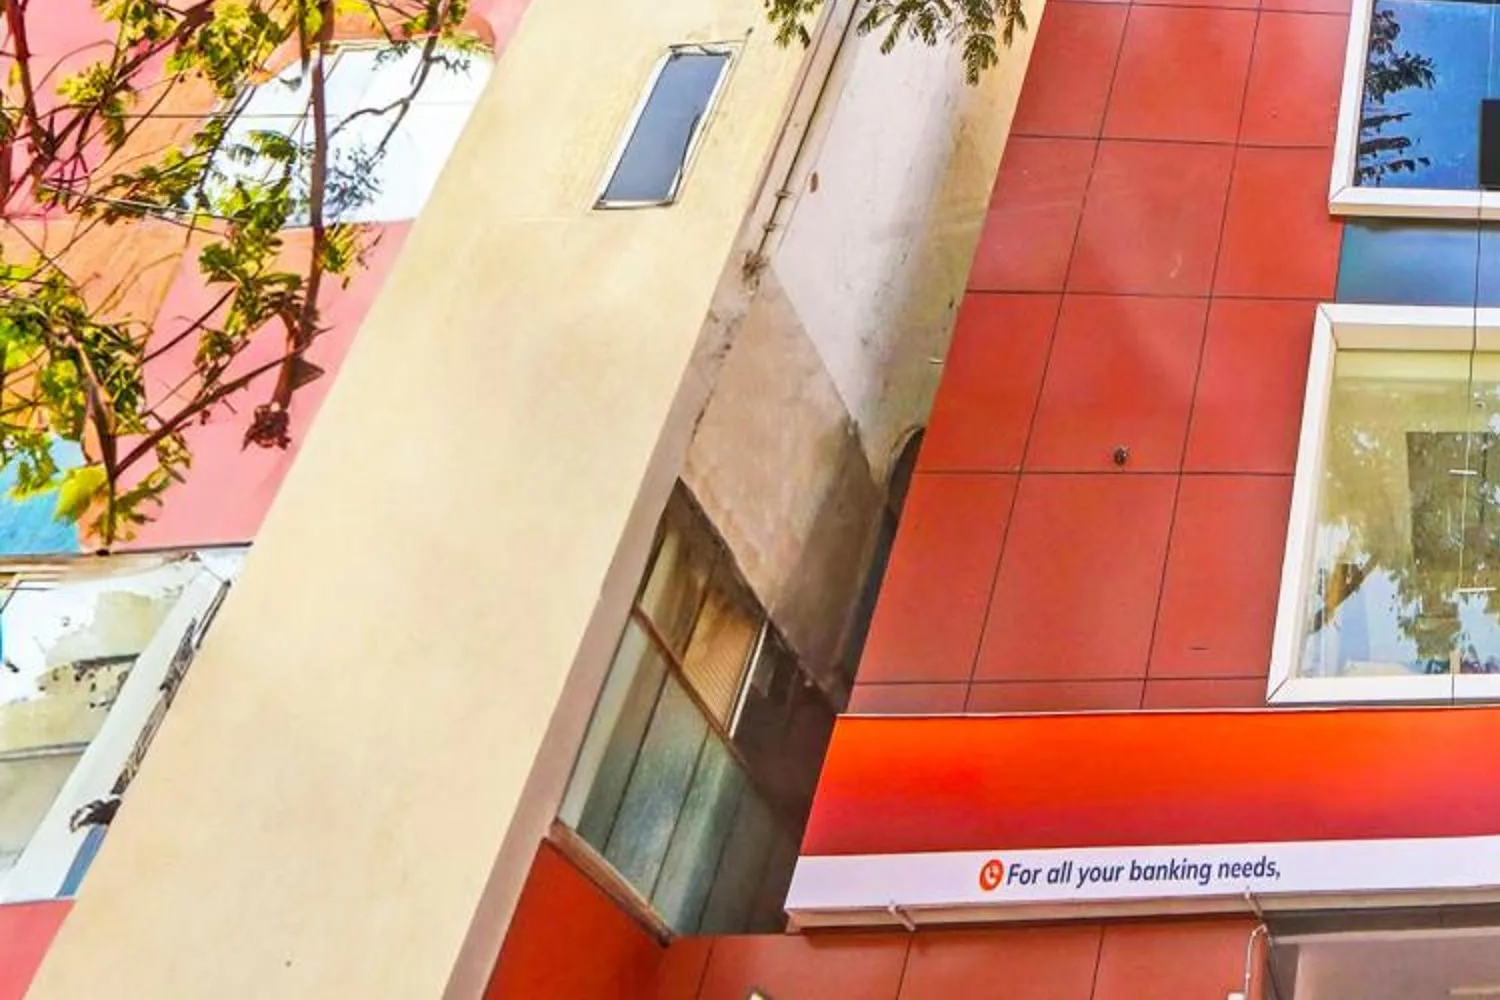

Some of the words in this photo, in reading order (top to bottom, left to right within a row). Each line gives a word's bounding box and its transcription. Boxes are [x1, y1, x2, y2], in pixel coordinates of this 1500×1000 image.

[1006, 862, 1041, 886] For
[1047, 860, 1073, 884] all
[1076, 862, 1125, 889] your
[1129, 858, 1212, 886] banking
[1217, 855, 1281, 879] needs,
